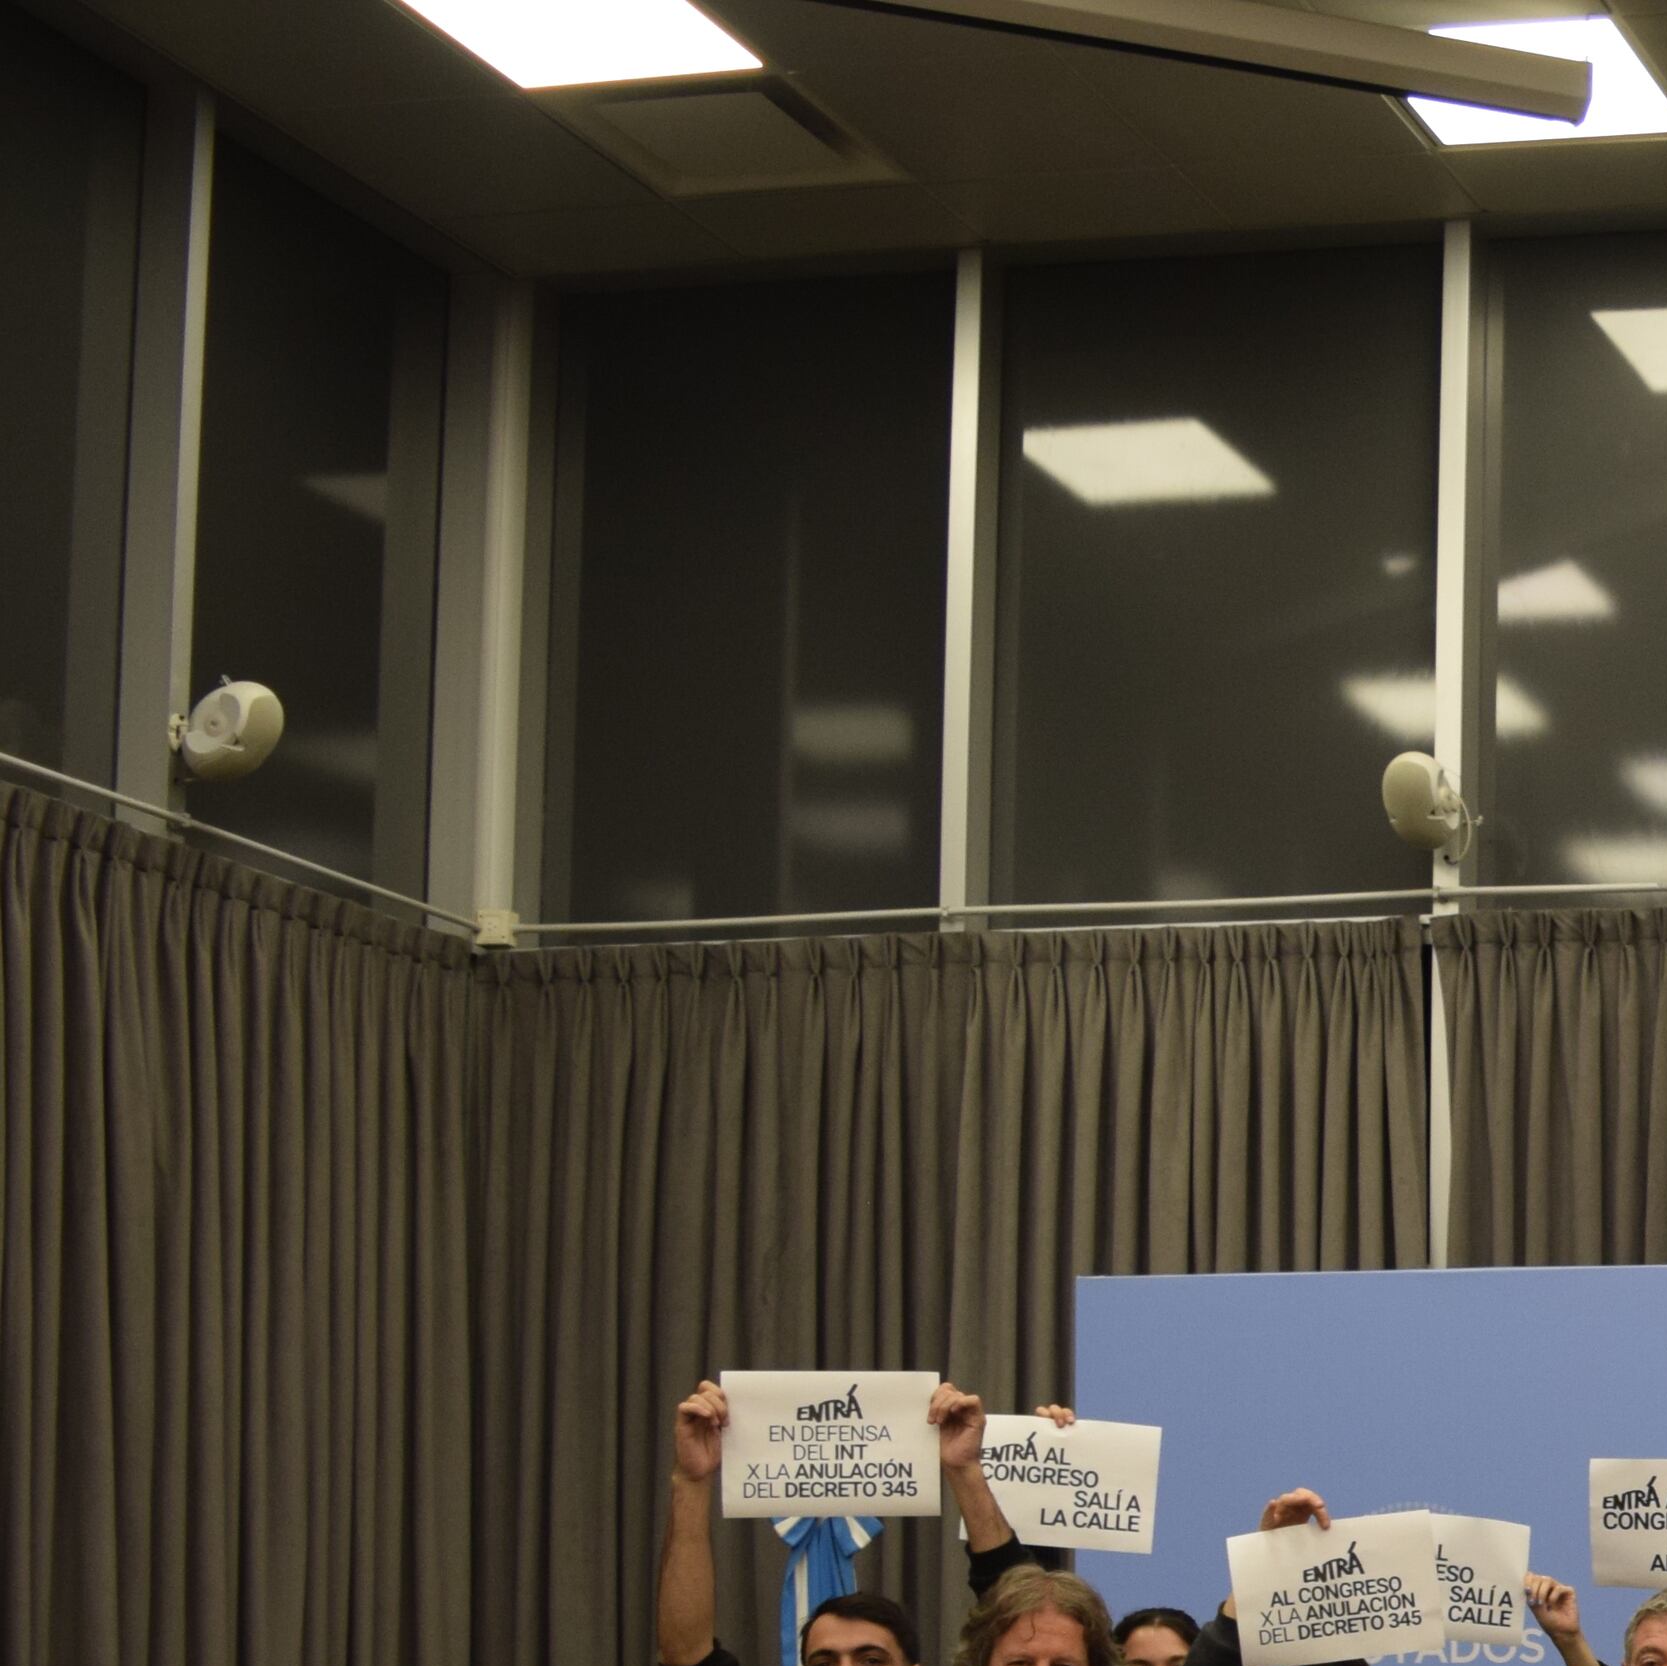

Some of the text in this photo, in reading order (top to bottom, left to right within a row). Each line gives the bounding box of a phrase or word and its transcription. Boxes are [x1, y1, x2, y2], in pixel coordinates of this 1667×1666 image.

[797, 1384, 863, 1422] ENTRÁ
[769, 1425, 892, 1442] EN DEFENSA
[794, 1444, 868, 1460] DEL INT
[748, 1458, 912, 1480] X LA ANULACIÓN
[743, 1481, 918, 1498] DEL DECRETO 345
